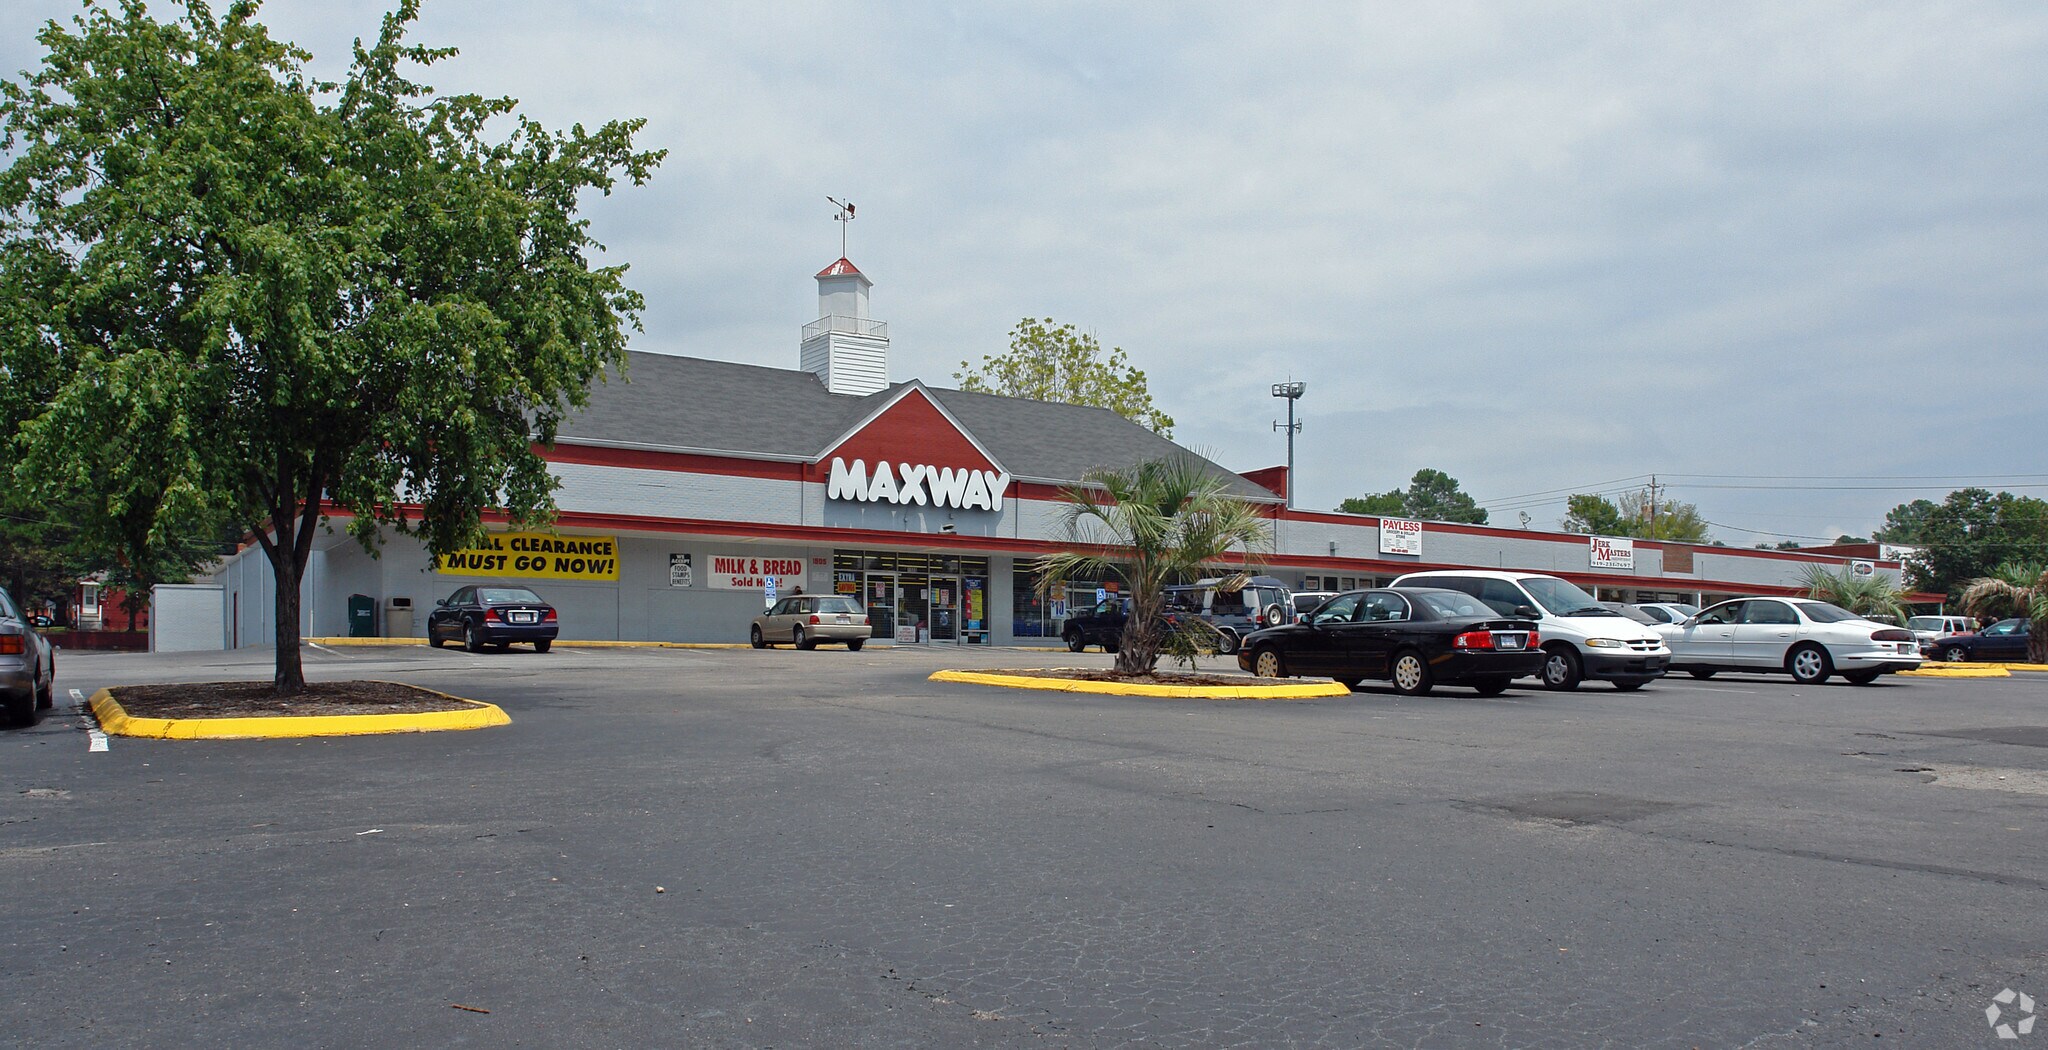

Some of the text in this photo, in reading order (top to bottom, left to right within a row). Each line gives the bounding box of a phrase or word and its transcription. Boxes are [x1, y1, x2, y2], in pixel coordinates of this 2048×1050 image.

[828, 457, 1010, 511] MAXWAY
[1383, 520, 1420, 531] PAYLESS
[510, 538, 612, 555] CLEARANCE
[1597, 547, 1631, 561] MASTERS
[447, 553, 614, 574] MUST GO NOW!
[715, 558, 801, 575] MILK & BREAD
[731, 577, 783, 588] Sold He!
[838, 572, 855, 582] EXTRA
